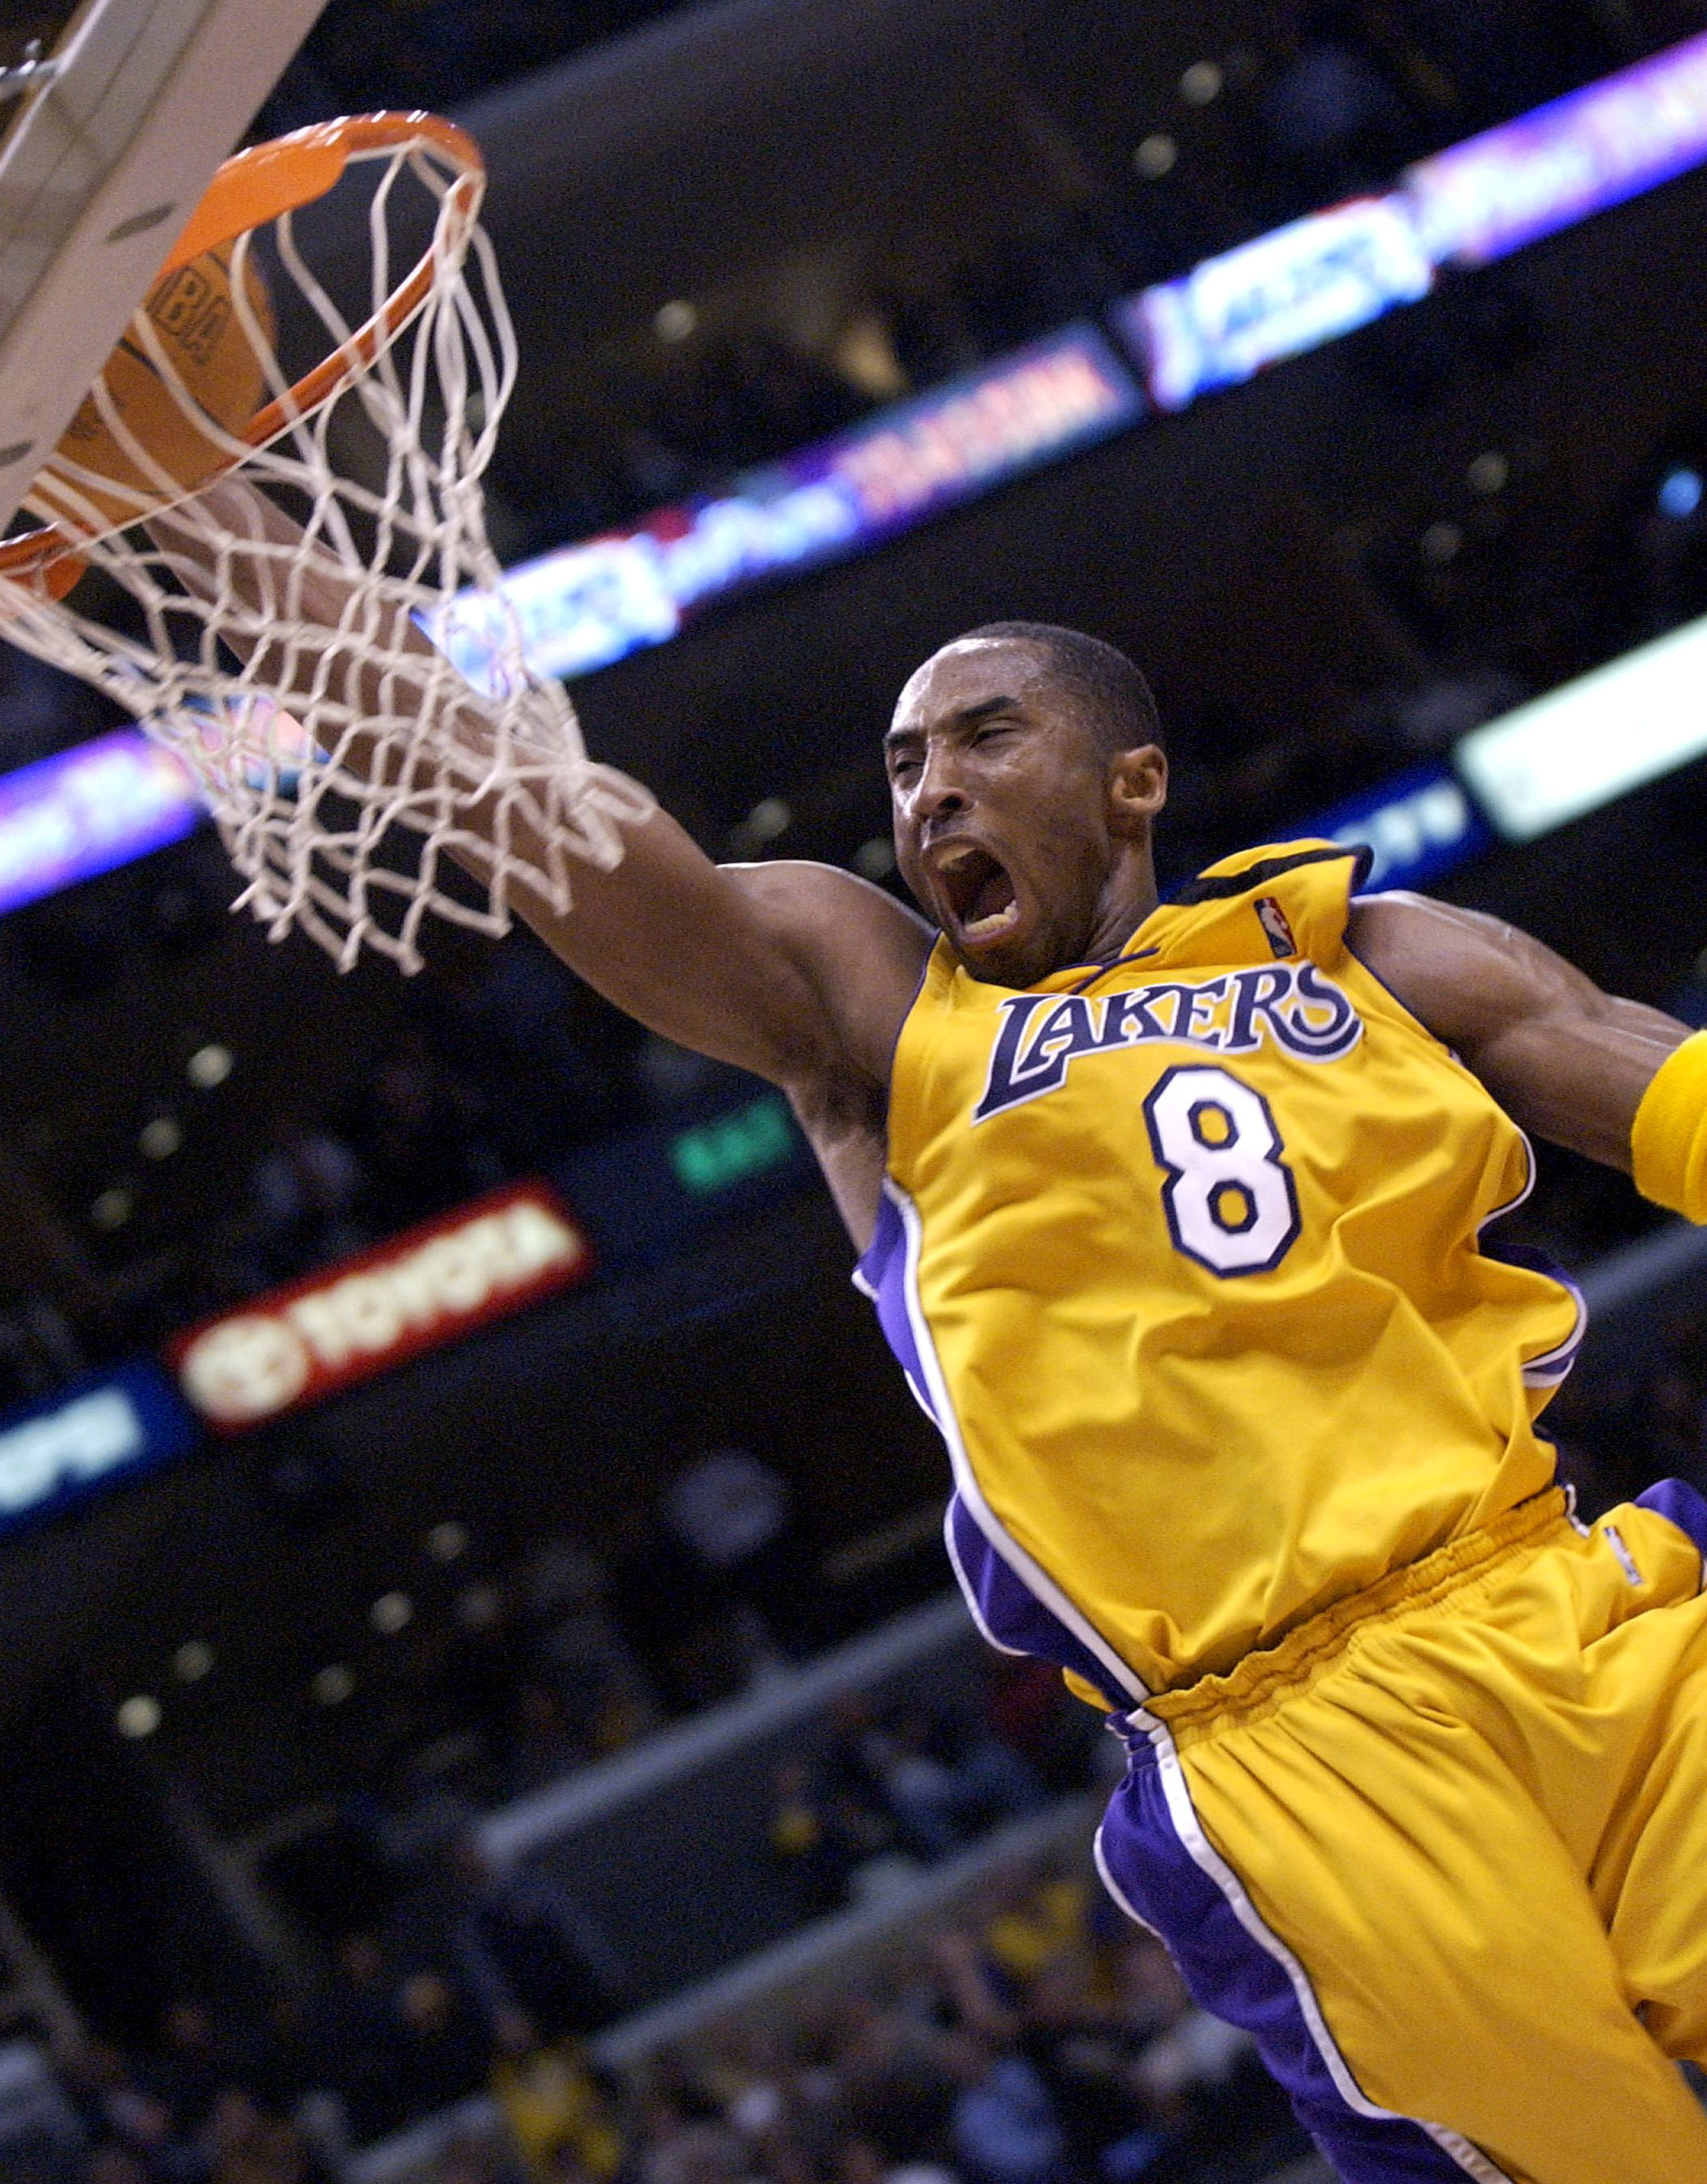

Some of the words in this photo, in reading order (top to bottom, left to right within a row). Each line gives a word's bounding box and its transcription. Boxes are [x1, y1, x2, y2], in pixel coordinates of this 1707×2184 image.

[145, 265, 231, 366] BA
[971, 961, 1364, 1128] LAKERS
[1142, 1062, 1303, 1280] 8
